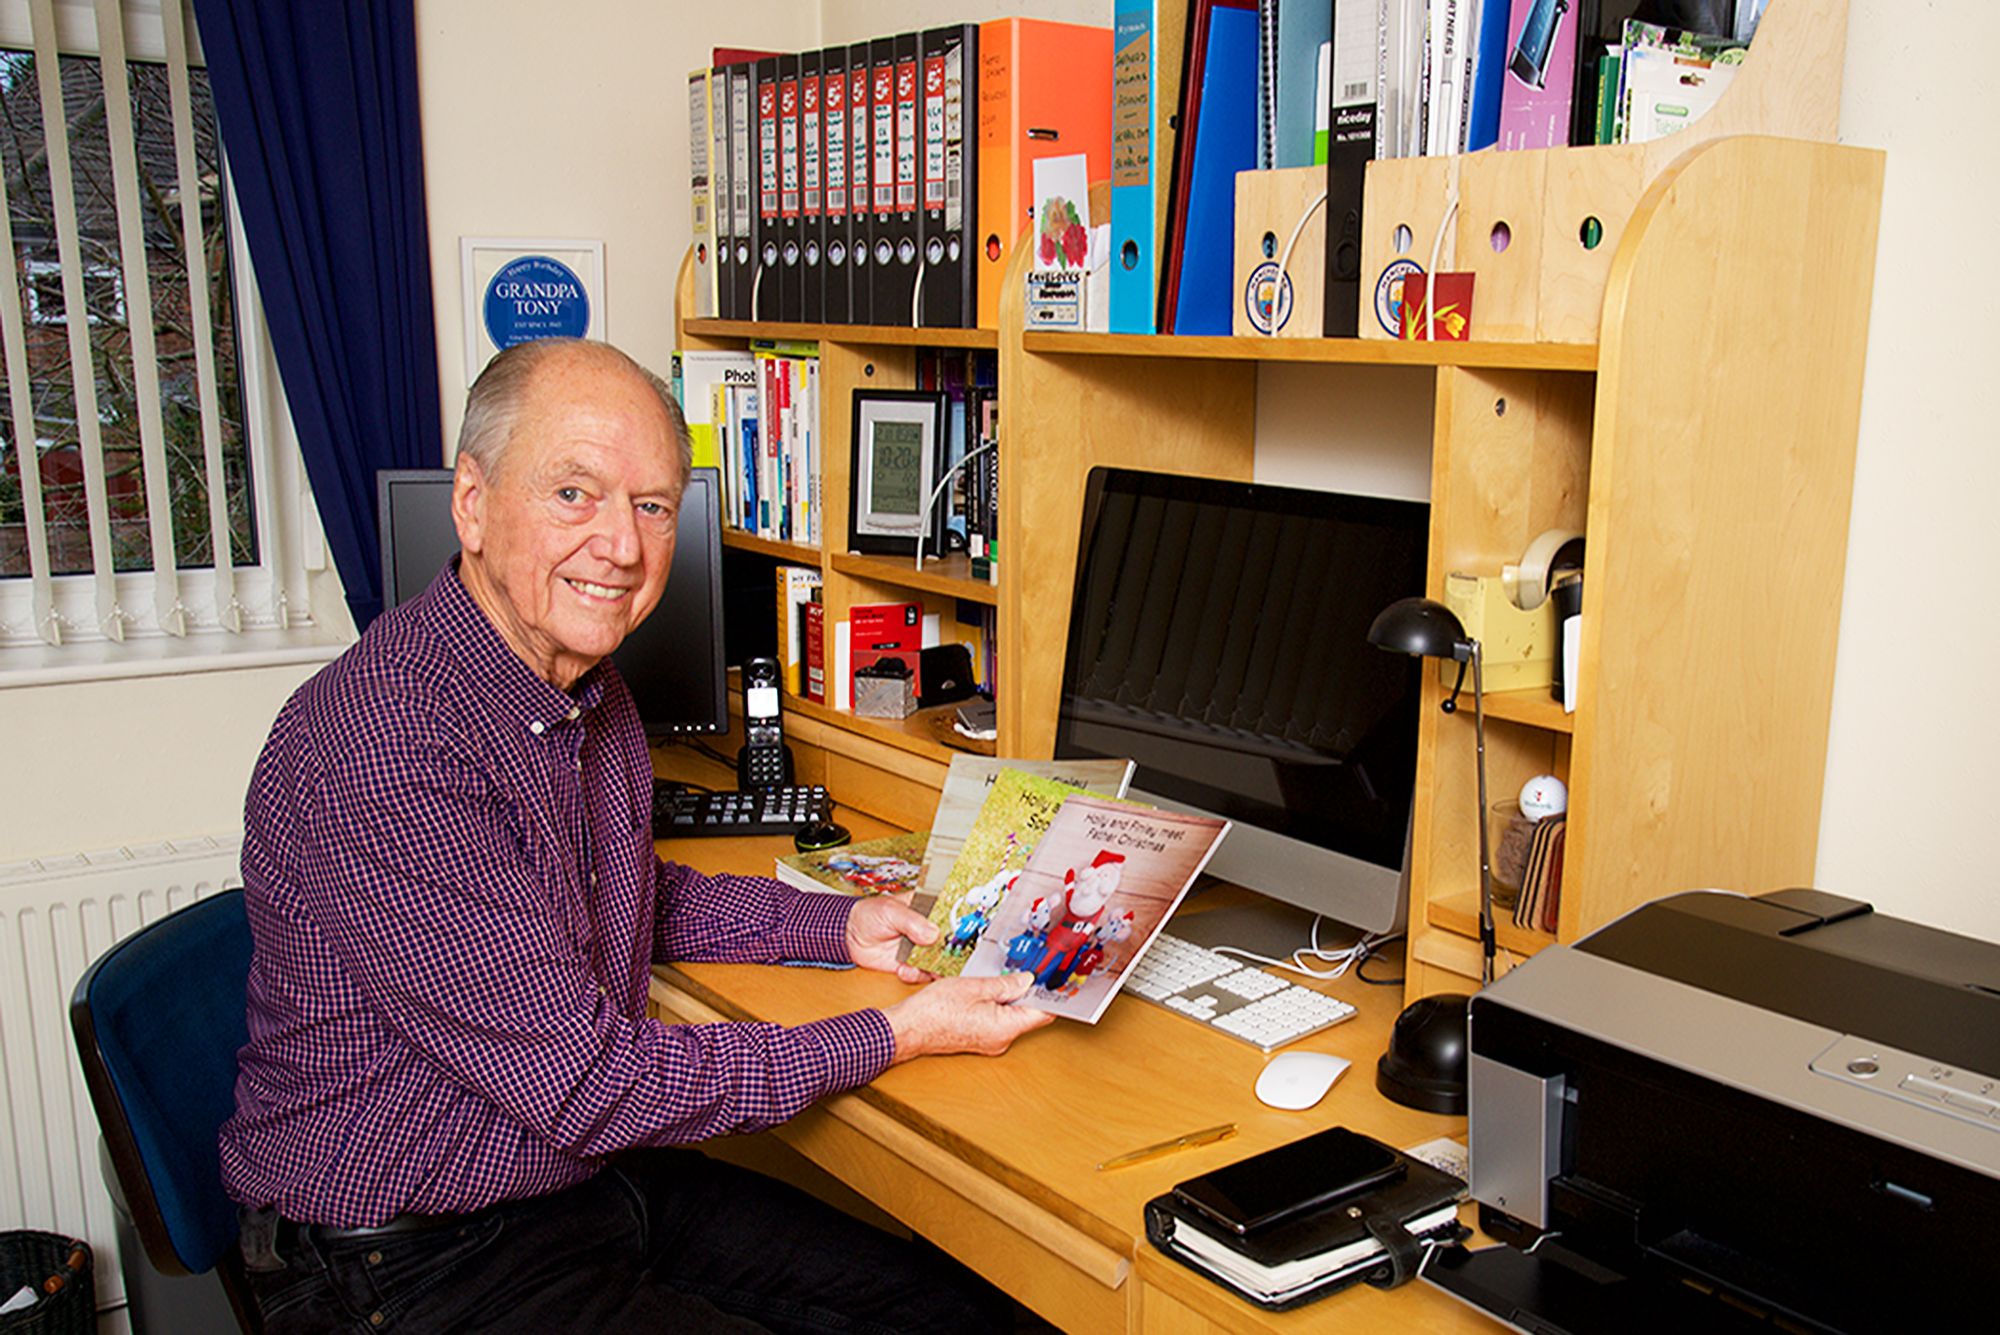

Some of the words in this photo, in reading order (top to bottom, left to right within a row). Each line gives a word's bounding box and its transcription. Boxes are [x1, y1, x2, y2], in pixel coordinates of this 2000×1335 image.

[1337, 109, 1372, 125] niceday
[495, 282, 579, 299] GRANDPA
[513, 300, 562, 315] TONY
[724, 369, 757, 382] Phot
